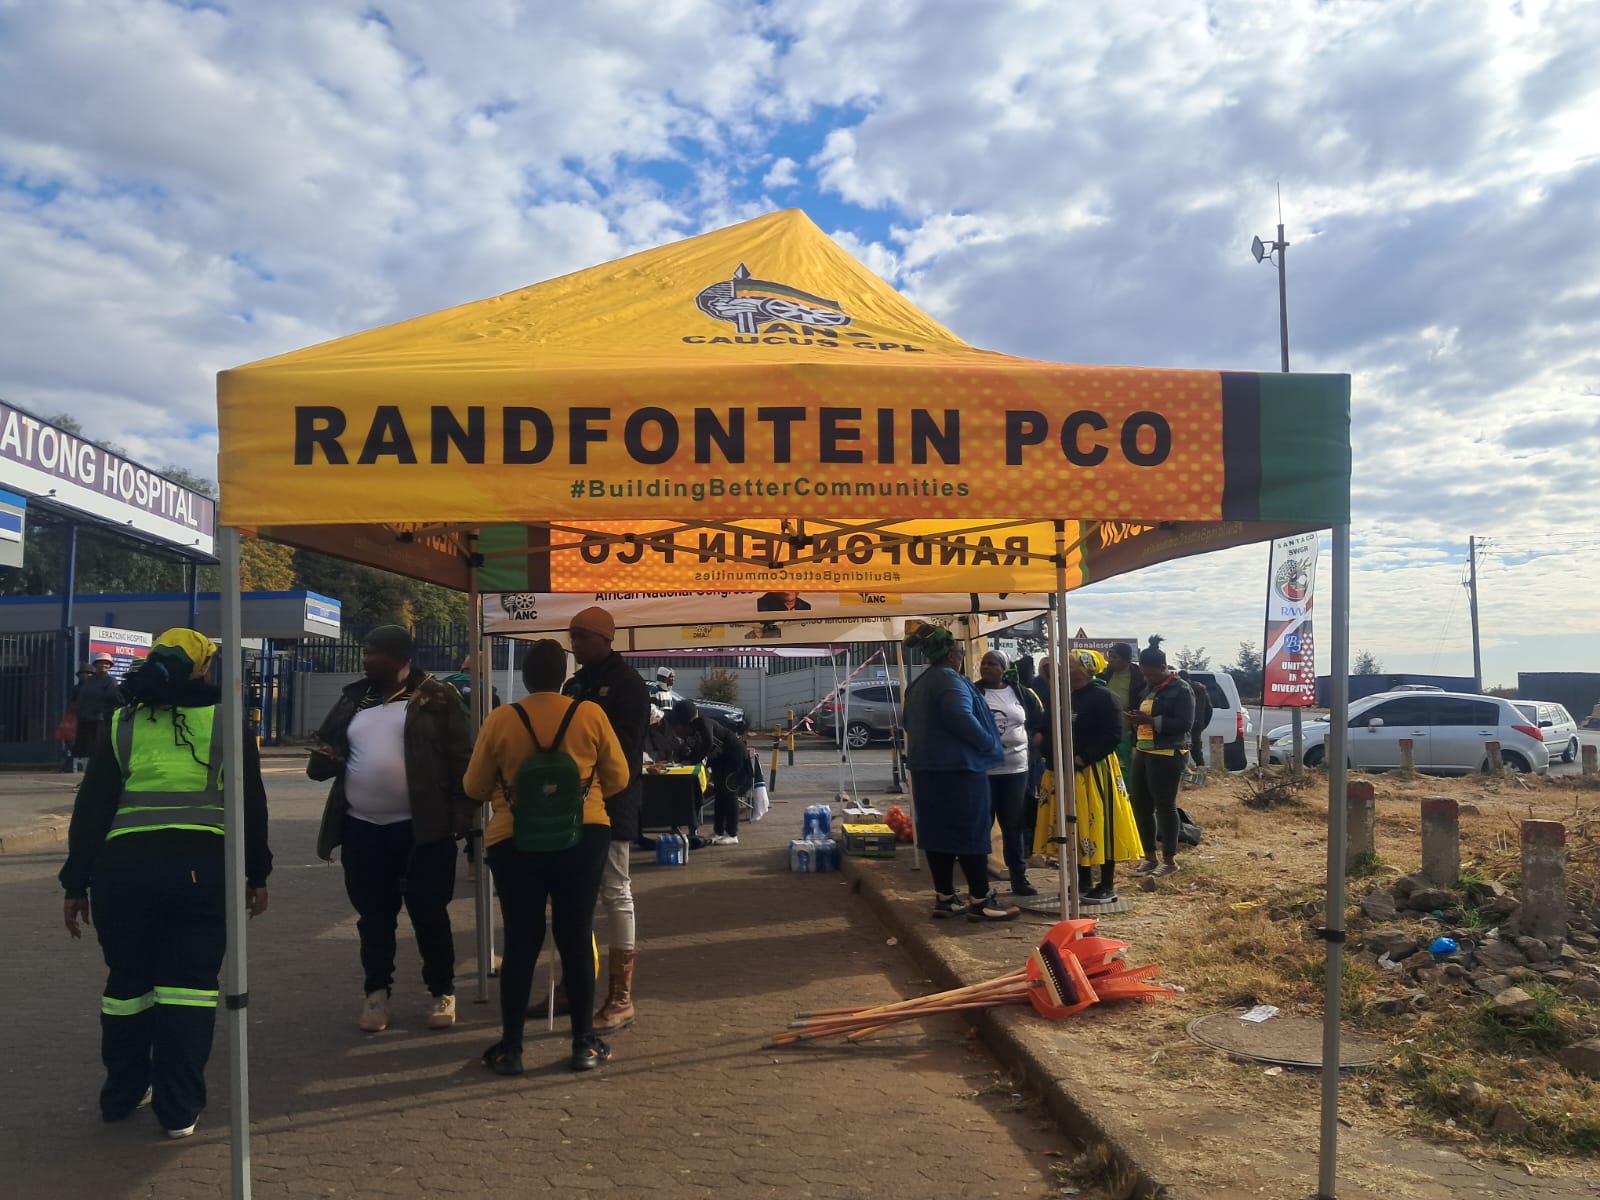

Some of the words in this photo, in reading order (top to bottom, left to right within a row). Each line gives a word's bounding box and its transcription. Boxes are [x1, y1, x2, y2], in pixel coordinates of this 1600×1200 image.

[682, 335, 839, 349] CAUCUS
[294, 405, 961, 465] RANDFONTEIN
[1005, 409, 1172, 468] PCO
[0, 410, 96, 484] ATONG
[103, 453, 199, 527] HOSPITAL
[570, 477, 969, 501] #BuildingBetterCommunities
[867, 594, 886, 604] ANC
[515, 610, 538, 621] ANC
[115, 645, 136, 656] NOTICE
[1281, 661, 1304, 670] UNIT
